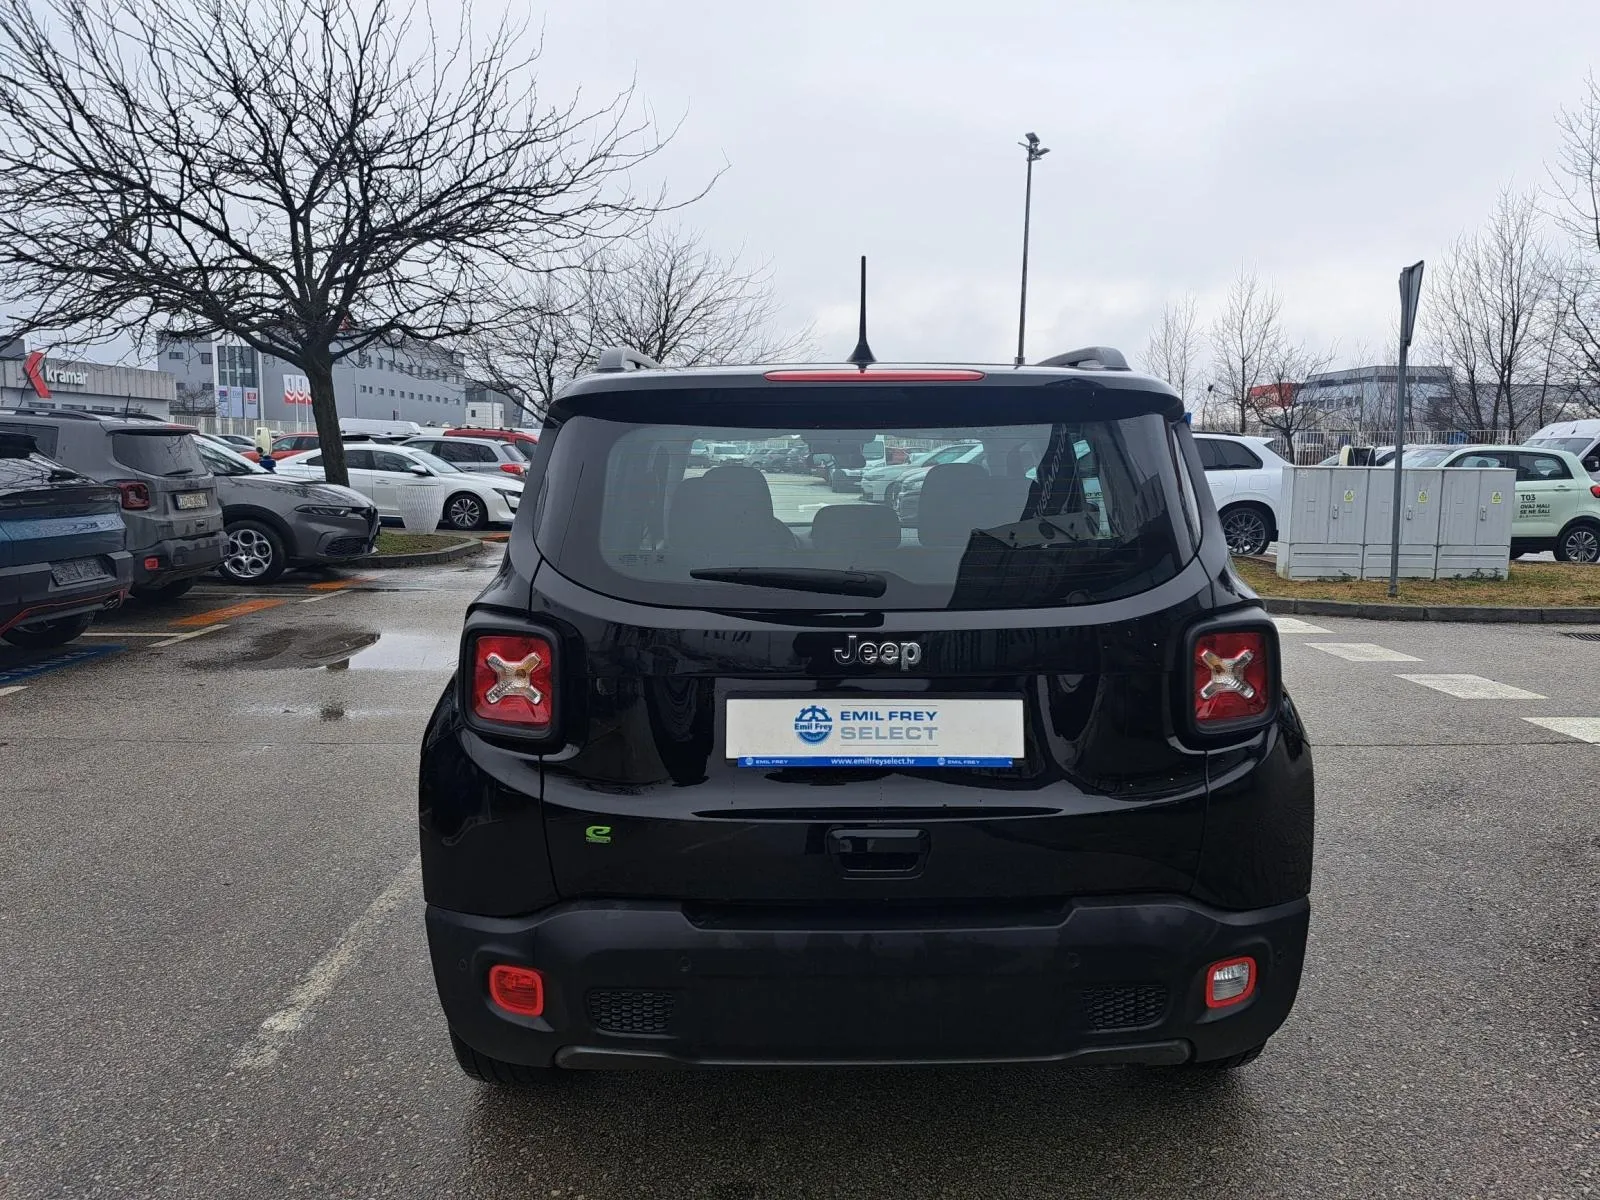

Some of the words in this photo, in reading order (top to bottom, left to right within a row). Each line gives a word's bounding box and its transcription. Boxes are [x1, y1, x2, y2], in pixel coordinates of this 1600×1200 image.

[46, 365, 88, 384] kramar
[834, 635, 922, 671] Jeep
[841, 711, 884, 721] EMIL
[888, 711, 937, 721] FREY
[815, 723, 833, 732] Frey
[841, 727, 937, 740] SELECT
[831, 757, 915, 766] www.emilfreyselect.hr
